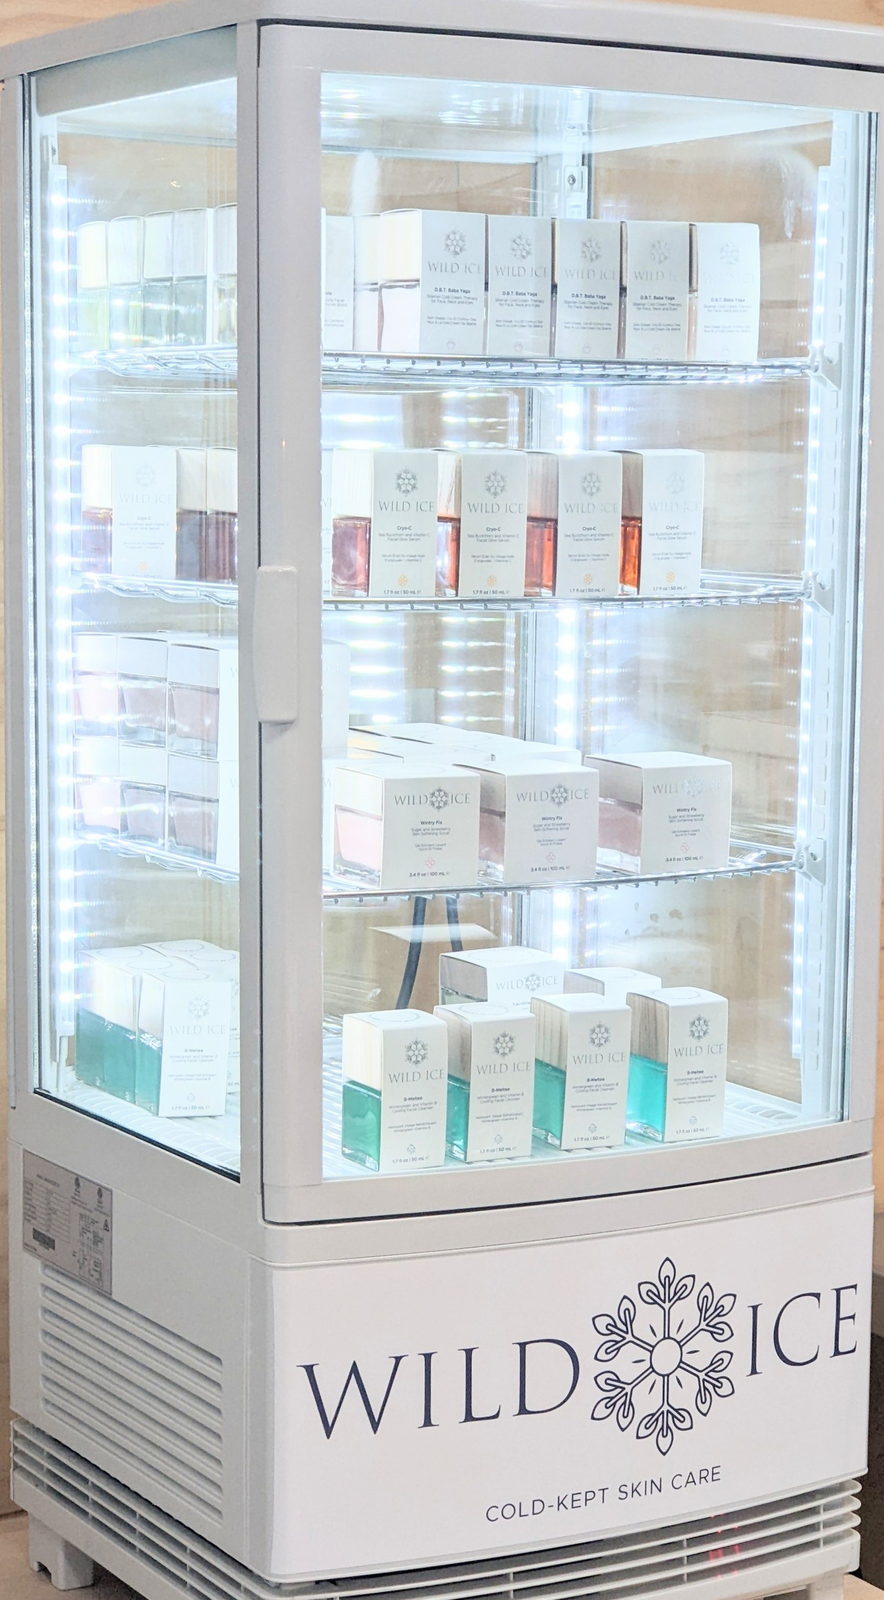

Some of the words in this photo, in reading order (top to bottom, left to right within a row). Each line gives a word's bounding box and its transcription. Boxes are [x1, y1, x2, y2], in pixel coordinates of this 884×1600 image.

[427, 261, 460, 273] WILD
[495, 265, 527, 278] WILD
[378, 500, 411, 512] WILD
[416, 500, 434, 512] ICE
[467, 502, 500, 513] WILD
[505, 503, 524, 514] ICE
[563, 502, 596, 513] WILD
[394, 794, 428, 806] WILD
[450, 792, 471, 804] ICE
[516, 790, 549, 802] WILD
[570, 788, 589, 800] ICE
[673, 1046, 703, 1057] WILD
[707, 1043, 724, 1055] ICE
[572, 1053, 604, 1065] WILD
[608, 1051, 626, 1063] ICE
[476, 1063, 508, 1075] WILD
[513, 1061, 531, 1072] ICE
[388, 1071, 422, 1084] WILD
[426, 1069, 445, 1081] ICE
[296, 1337, 581, 1440] WILD
[746, 1283, 859, 1378] ICE
[486, 1487, 607, 1523] COLD-KEPT
[618, 1477, 663, 1501] SKIN
[671, 1465, 722, 1490] CARE
